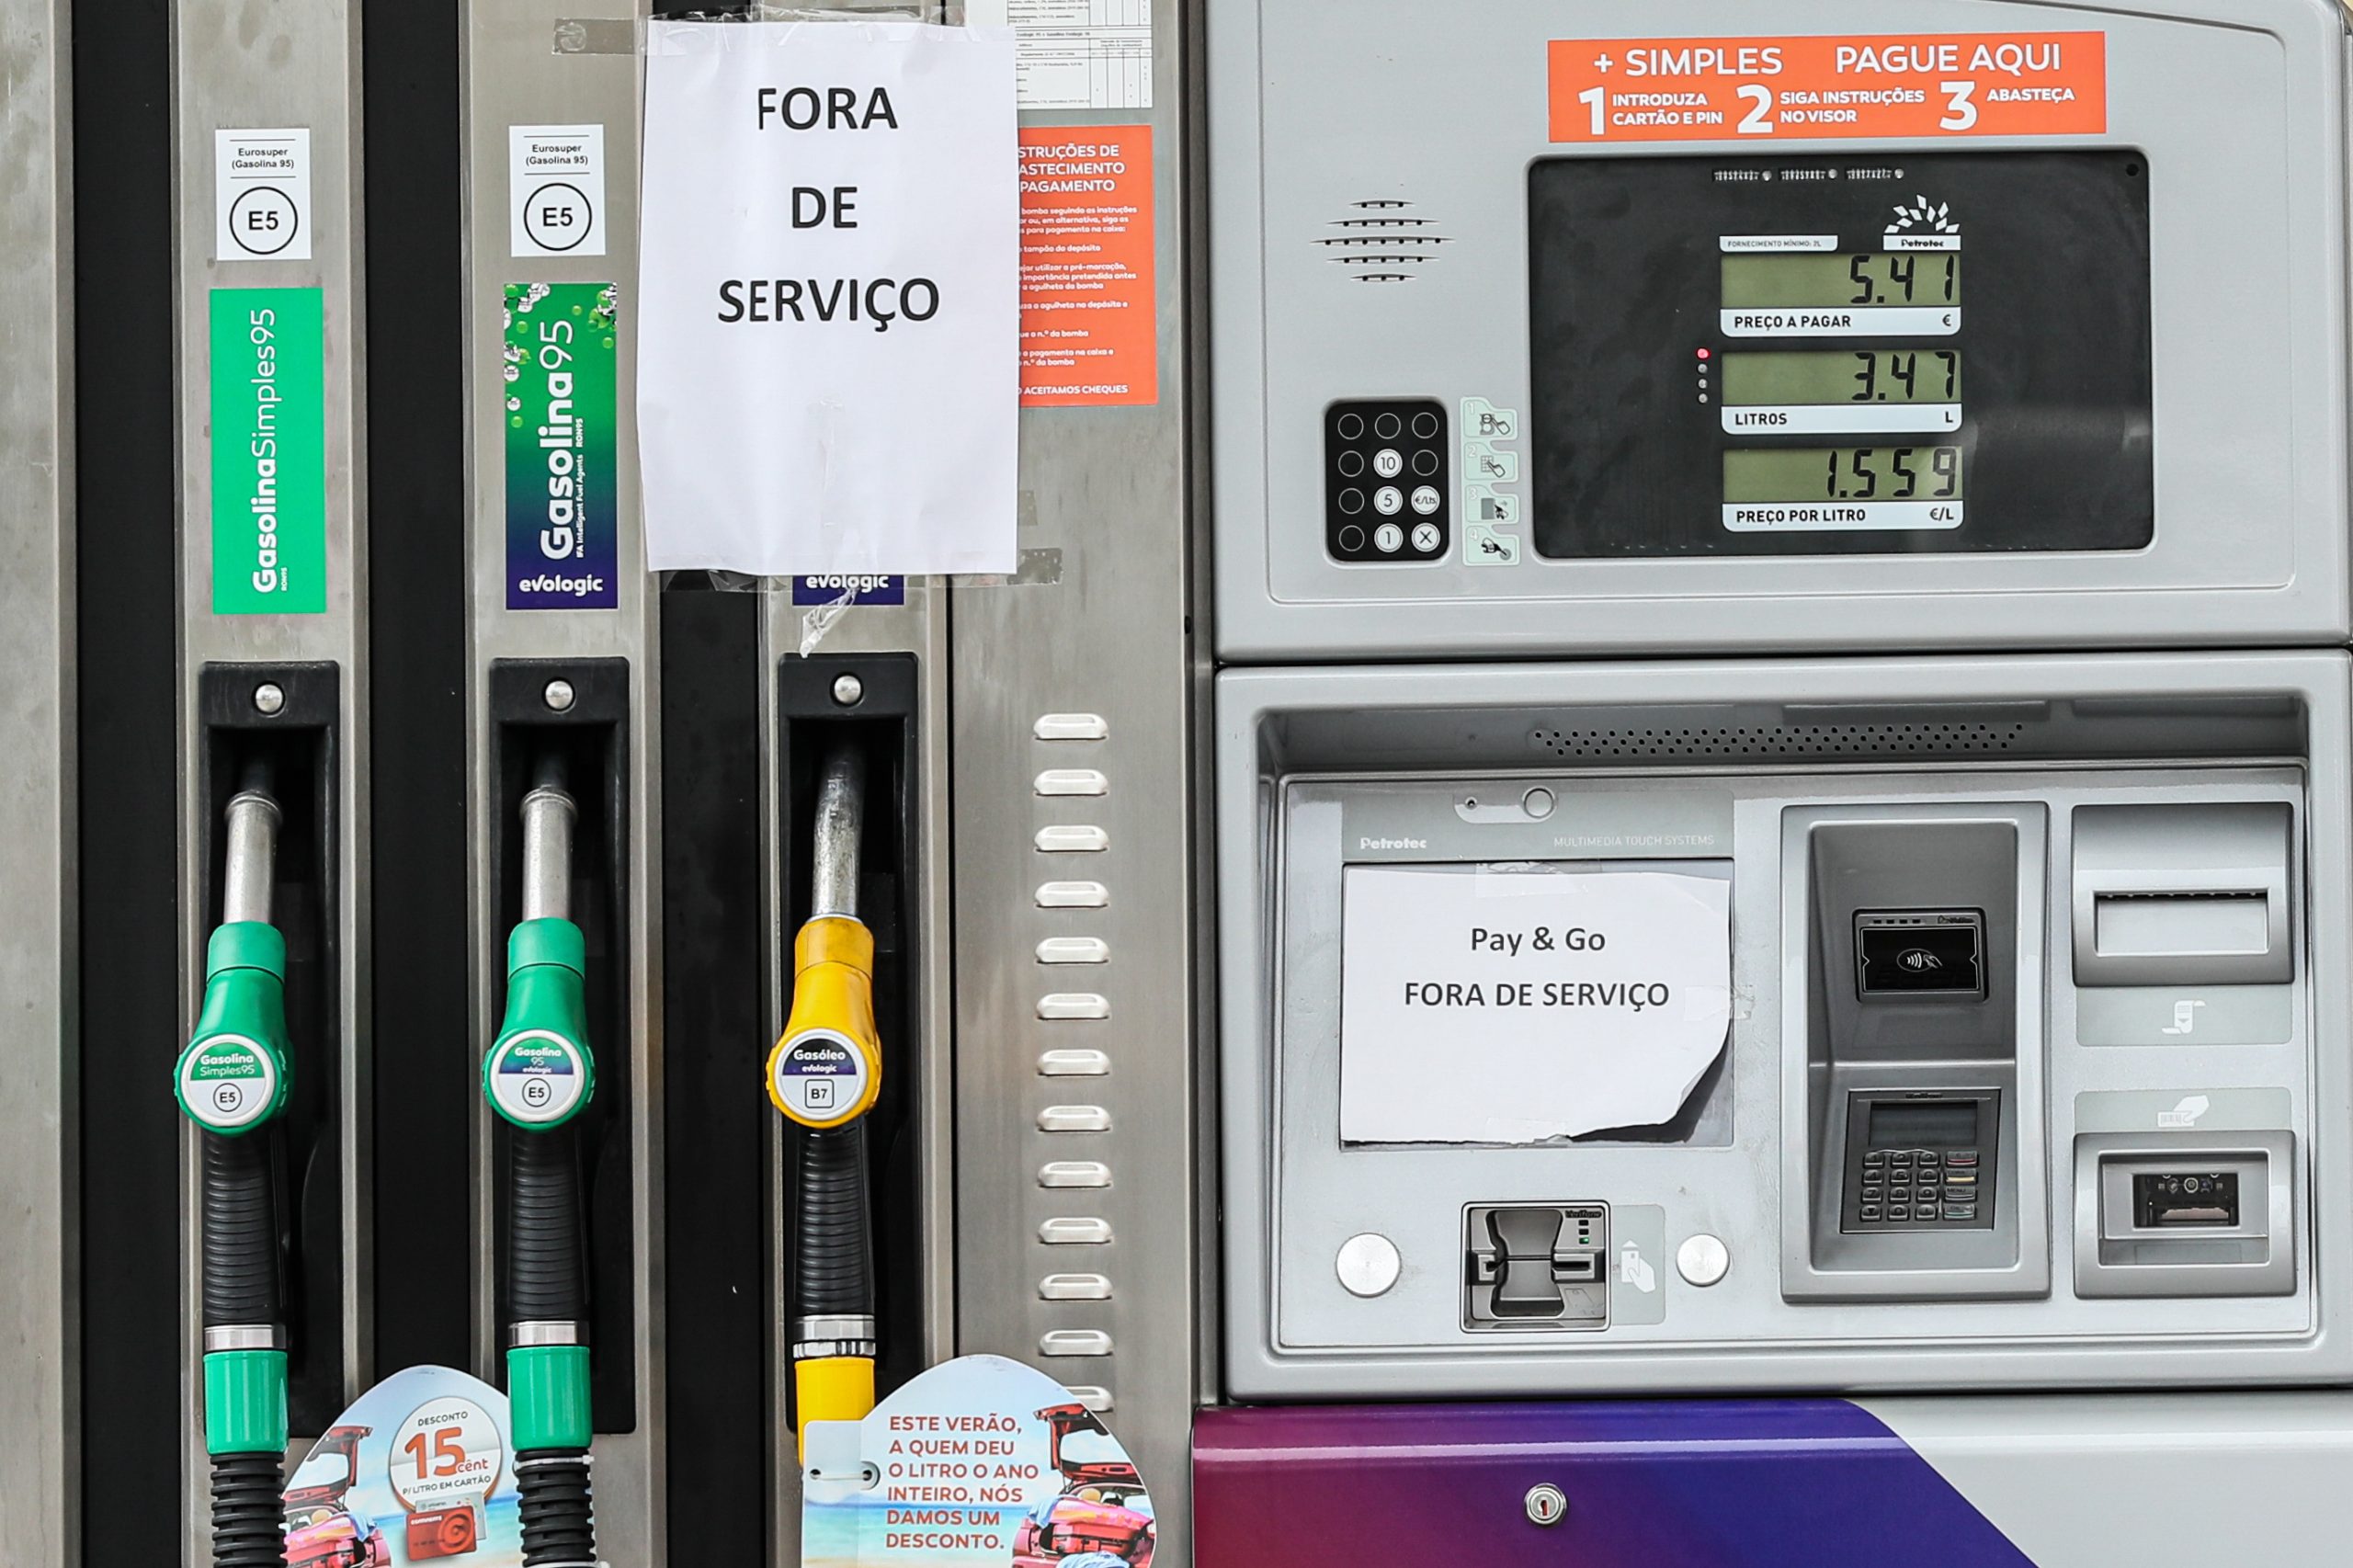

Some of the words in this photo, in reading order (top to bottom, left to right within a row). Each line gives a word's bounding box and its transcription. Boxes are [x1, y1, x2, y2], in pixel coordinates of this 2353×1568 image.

[1625, 47, 1782, 76] SIMPLES
[1836, 44, 1959, 74] PAGUE
[1968, 43, 2061, 76] AQUI
[1612, 93, 1708, 107] INTRODUZA
[1779, 91, 1820, 105] SIGA
[1823, 87, 1925, 107] INSTRUÇÕES
[1986, 87, 2075, 104] ABASTEÇA
[758, 87, 898, 130] FORA
[1578, 86, 1606, 135] 1
[1736, 84, 1774, 134] 2
[1939, 81, 1978, 131] 3
[1612, 108, 1680, 125] CARTÃO
[1683, 112, 1692, 124] E
[1696, 111, 1723, 124] PIN
[1779, 110, 1806, 123] NO
[1807, 109, 1858, 123] VISOR
[238, 148, 288, 157] Eurosuper
[532, 143, 582, 154] Eurosuper
[1018, 143, 1096, 160] STRUÇÕES
[1099, 145, 1120, 157] DE
[232, 160, 277, 170] (Gasolina
[280, 159, 294, 170] 95)
[526, 155, 571, 166] (Gasolina
[574, 154, 588, 165] 95)
[1019, 162, 1125, 175] ASTECIMENTO
[1020, 179, 1116, 193] PAGAMENTO
[791, 187, 858, 228] DE
[1021, 207, 1049, 215] bomba
[1050, 207, 1085, 216] seguindo
[1097, 206, 1137, 215] instruções
[248, 210, 279, 231] E5
[542, 207, 574, 227] E5
[1055, 216, 1101, 224] alternativa,
[1102, 216, 1118, 224] siga
[1026, 227, 1044, 235] para
[1045, 226, 1090, 235] pagamento
[1024, 244, 1053, 254] tampão
[1067, 244, 1101, 253] depósito
[1783, 239, 1812, 248] MÍNIMO:
[1901, 239, 1944, 248] Petrotec
[1035, 263, 1062, 271] utilizar
[1023, 273, 1070, 281] importância
[1071, 272, 1112, 281] pretendida
[1849, 255, 1955, 304] 5.41
[1029, 282, 1063, 292] agulheta
[718, 278, 939, 332] SERVIÇO
[1087, 301, 1121, 310] depósito
[1734, 315, 1783, 331] PREÇO
[1787, 316, 1797, 327] A
[1801, 315, 1851, 327] PAGAR
[1942, 314, 1951, 326] €
[1061, 329, 1089, 337] bomba
[1029, 349, 1074, 358] pagamento
[1851, 351, 1956, 401] 3.47
[1024, 385, 1080, 395] ACEITAMOS
[1082, 384, 1129, 395] CHEQUES
[1734, 413, 1788, 426] LITROS
[1946, 412, 1953, 423] L
[575, 418, 585, 448] RON95
[249, 308, 282, 594] GasolinaSimples95
[575, 454, 586, 480] Agents
[1381, 457, 1396, 470] 10
[1826, 448, 1957, 497] 1.559
[575, 483, 584, 503] Fuel
[1383, 494, 1392, 506] 5
[1736, 510, 1785, 526] PREÇO
[1790, 509, 1819, 522] POR
[1823, 508, 1866, 522] LITRO
[1929, 507, 1954, 521] €/L
[575, 503, 586, 543] Intelligent
[1385, 531, 1392, 544] 1
[519, 574, 604, 597] evologic
[1360, 837, 1427, 850] Petrotec
[1554, 835, 1622, 847] MULTIMEDIA
[1624, 835, 1663, 846] TOUCH
[1665, 835, 1715, 846] SYSTEMS
[1472, 928, 1523, 957] Pay
[1532, 926, 1555, 951] &
[1565, 928, 1606, 951] Go
[1405, 983, 1485, 1006] FORA
[1496, 983, 1533, 1006] DE
[1542, 983, 1670, 1012] SERVIÇO
[200, 1052, 254, 1065] Gasolina
[515, 1047, 563, 1057] Gasolina
[793, 1049, 847, 1061] Gasóleo
[530, 1057, 544, 1066] 95
[200, 1064, 255, 1077] Simples95
[219, 1092, 236, 1103] E5
[529, 1087, 545, 1098] E5
[811, 1088, 828, 1099] B7
[417, 1411, 469, 1426] DESCONTO
[889, 1415, 939, 1431] ESTE
[945, 1412, 1022, 1435] VERÃO,
[404, 1426, 466, 1480] 15
[457, 1458, 489, 1473] cênt
[888, 1439, 904, 1455] A
[909, 1439, 970, 1458] QUEM
[974, 1439, 1015, 1455] DEU
[888, 1463, 904, 1479] O
[908, 1463, 968, 1479] LITRO
[972, 1463, 987, 1479] O
[993, 1464, 1040, 1480] ANO
[413, 1482, 438, 1494] LITRO
[439, 1480, 453, 1489] EM
[454, 1474, 492, 1487] CARTÃO
[887, 1486, 973, 1505] INTEIRO,
[980, 1483, 1023, 1502] NÓS
[886, 1510, 963, 1525] DAMOS
[968, 1510, 1000, 1525] UM
[885, 1532, 1005, 1549] DESCONTO.
